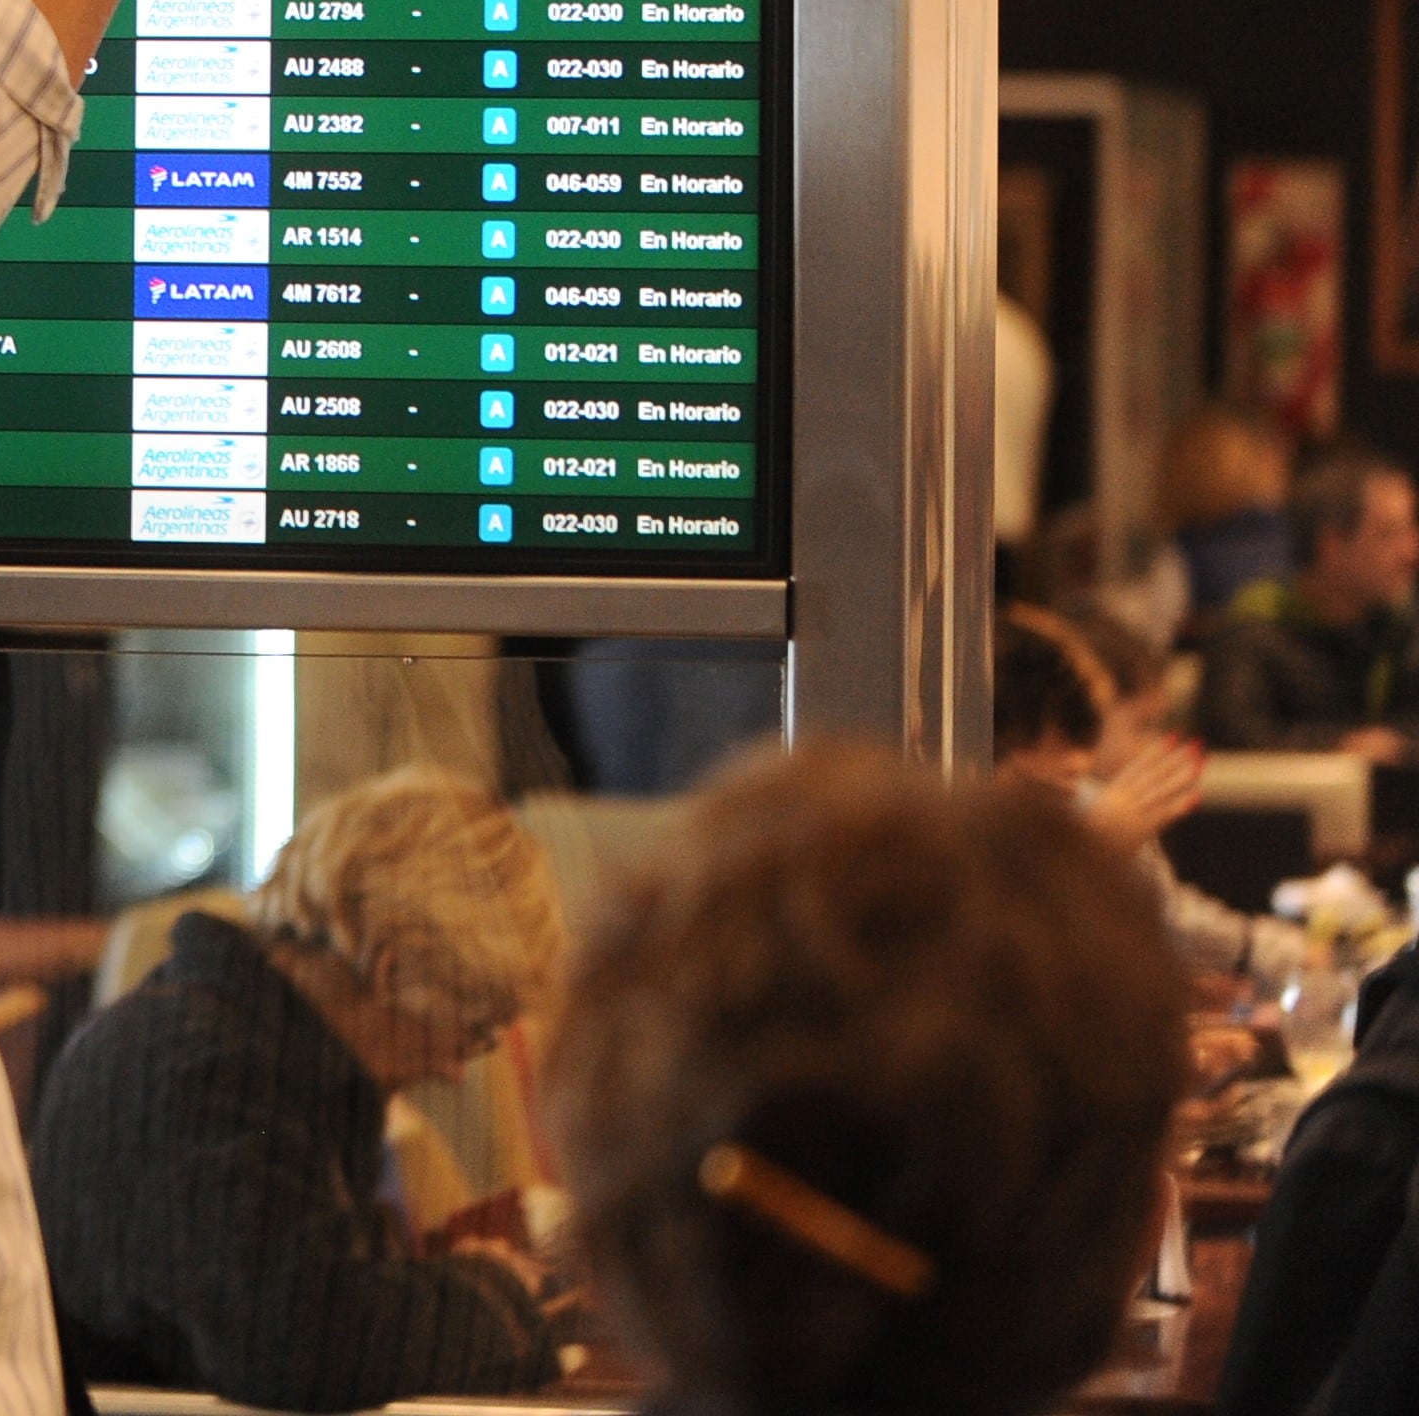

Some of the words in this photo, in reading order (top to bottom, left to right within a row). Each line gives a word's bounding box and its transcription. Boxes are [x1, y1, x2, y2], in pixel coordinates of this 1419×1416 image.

[280, 510, 309, 527] AU
[314, 510, 359, 528] 2718
[488, 513, 503, 531] A
[543, 514, 618, 532] 022-030
[637, 516, 664, 533] En
[669, 516, 739, 535] Horario
